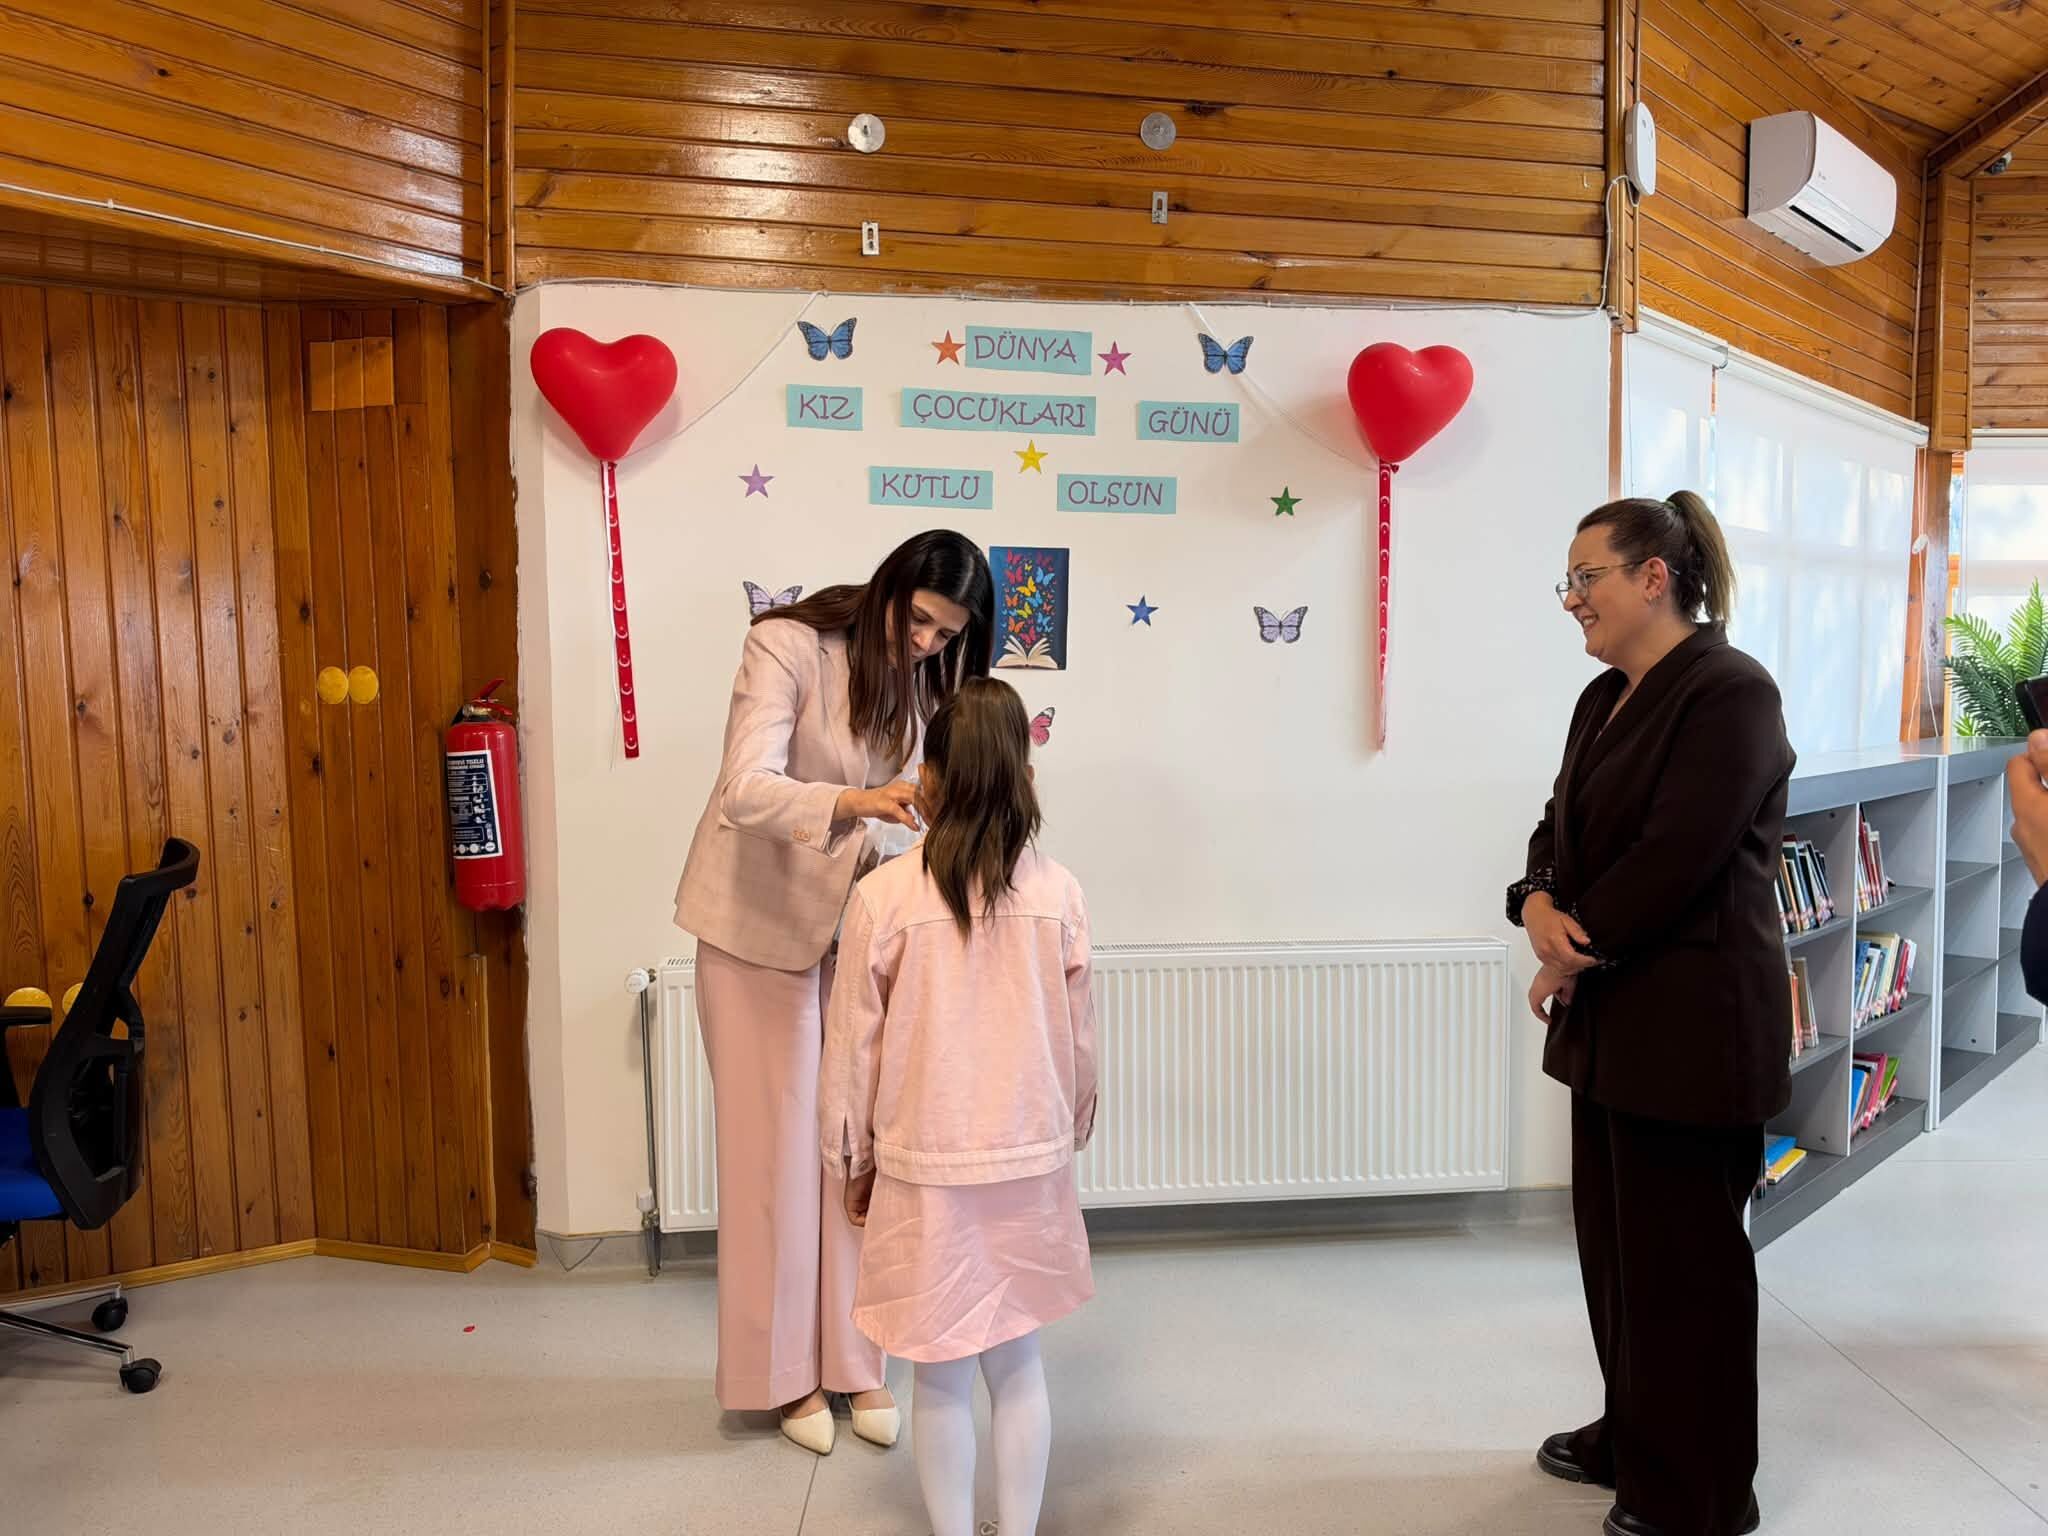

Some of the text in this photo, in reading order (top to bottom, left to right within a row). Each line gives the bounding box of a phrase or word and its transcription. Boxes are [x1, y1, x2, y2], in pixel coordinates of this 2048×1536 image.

[975, 330, 1076, 363] DÜNYA
[799, 393, 1231, 436] KIZ ÇOCUKLARI GÜNÜ
[881, 473, 1163, 506] KUTLU OLSUN
